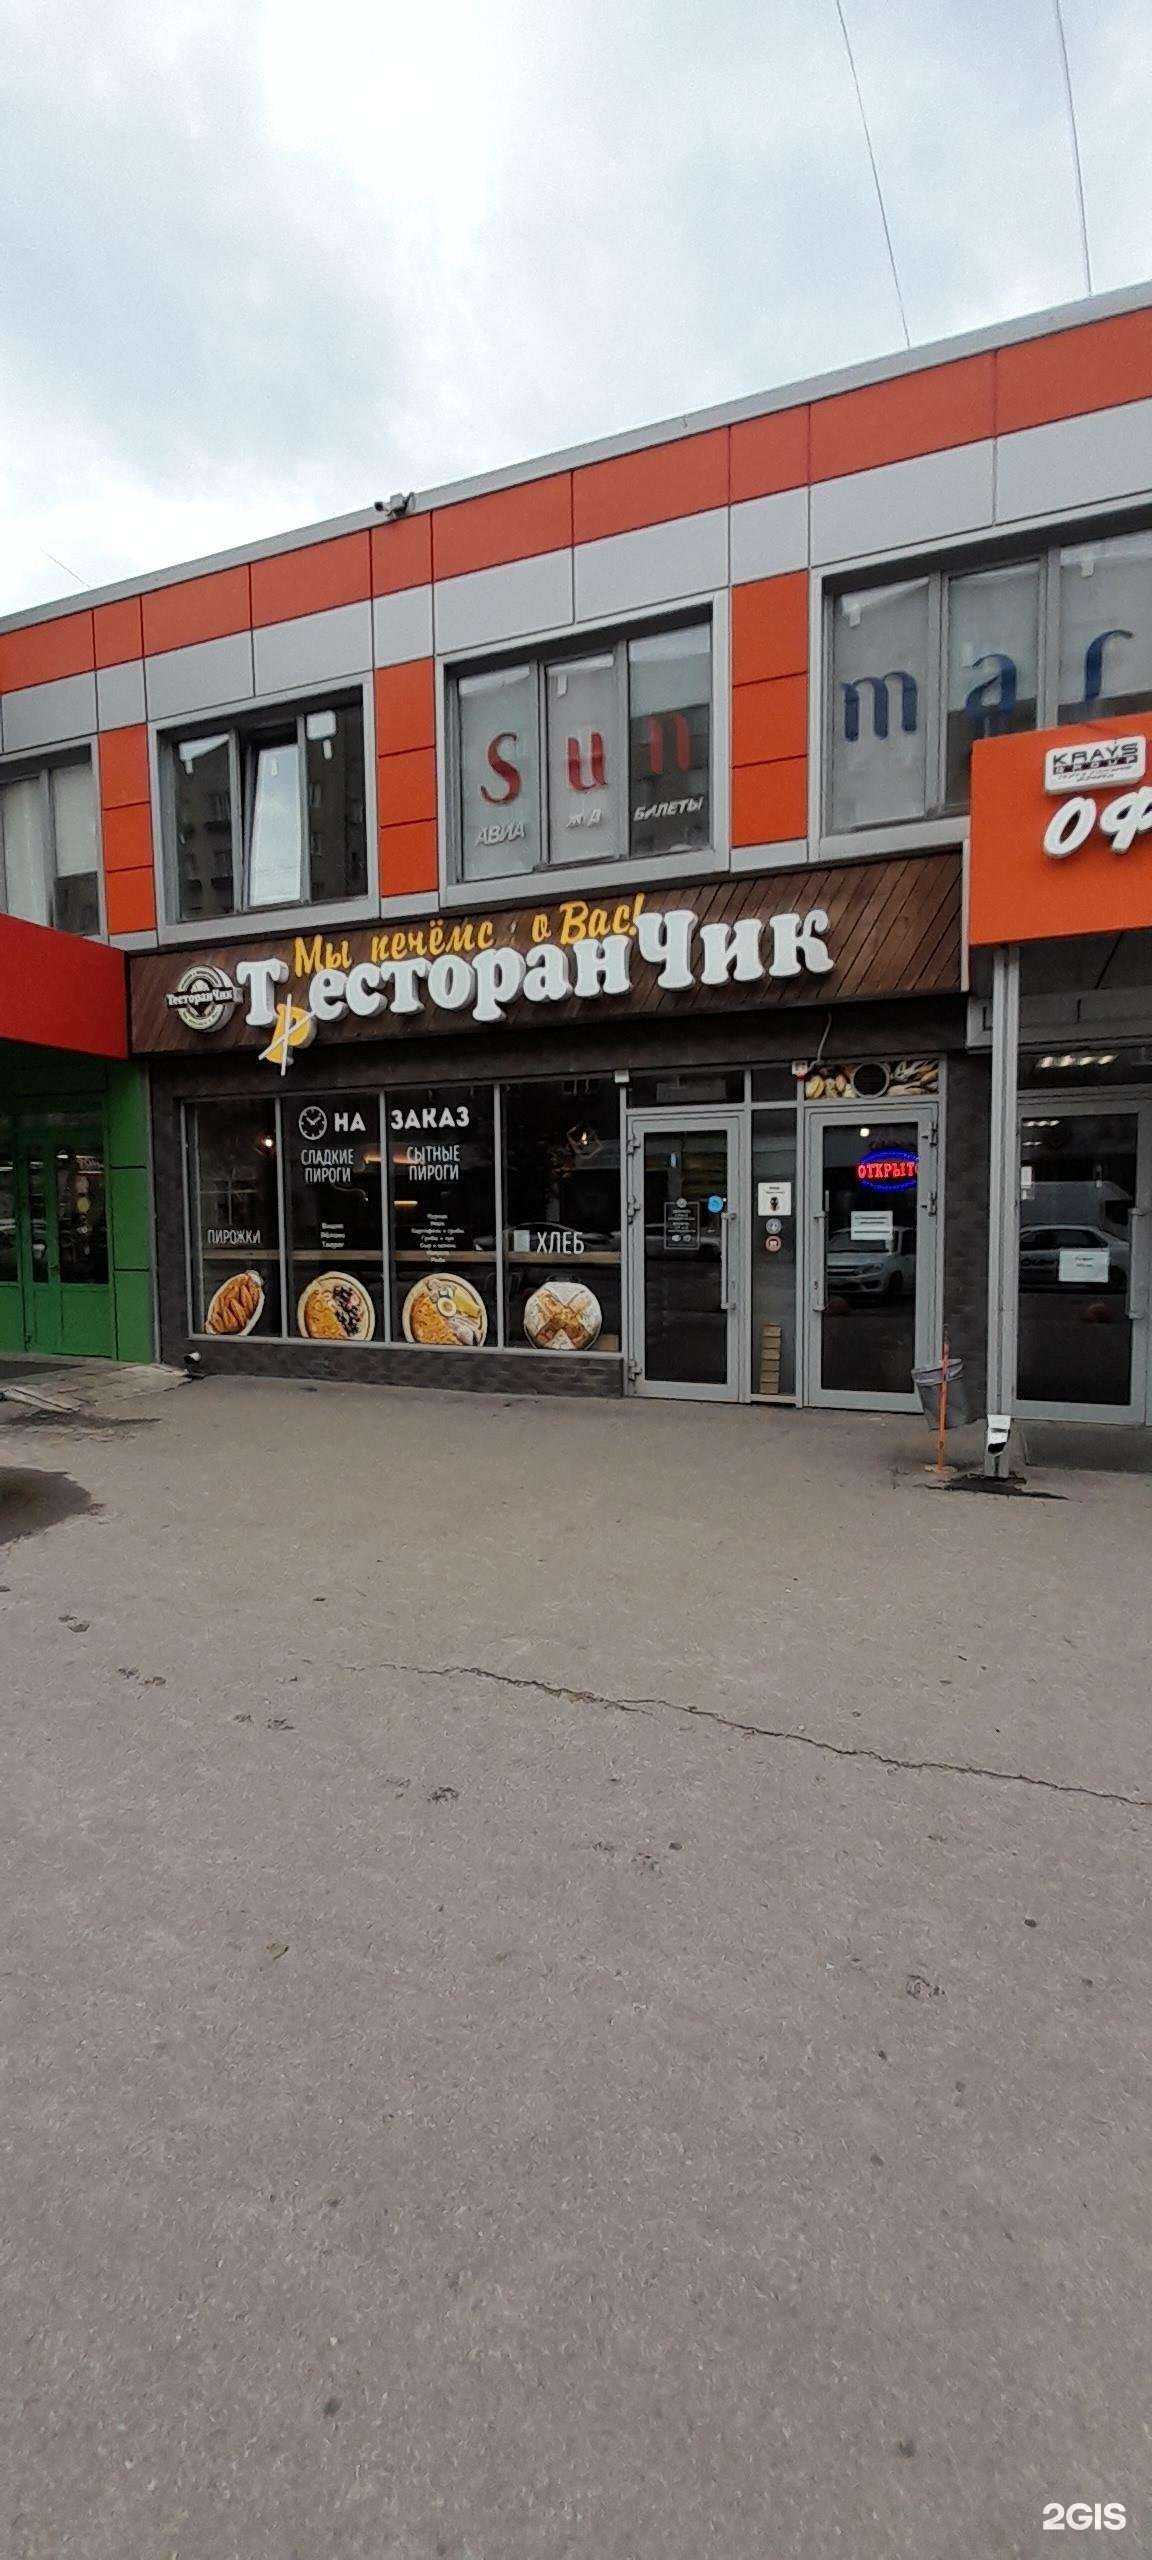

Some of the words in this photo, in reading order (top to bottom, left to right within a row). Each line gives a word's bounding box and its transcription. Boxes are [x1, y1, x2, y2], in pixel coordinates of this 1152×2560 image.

[633, 797, 704, 822] БИЛЕТЫ
[294, 935, 351, 977] Мы
[559, 892, 645, 944] Вас!
[334, 1112, 366, 1132] НА
[391, 1106, 470, 1130] ЗАКАЗ
[301, 1149, 354, 1167] СЛАДКИЕ
[406, 1145, 461, 1164] СЫТНЫЕ
[304, 1168, 351, 1183] ПИРОГИ
[409, 1165, 460, 1181] ПИРОГИ
[207, 1229, 261, 1245] ПИРОЖКИ
[536, 1231, 585, 1254] ХЛЕБ
